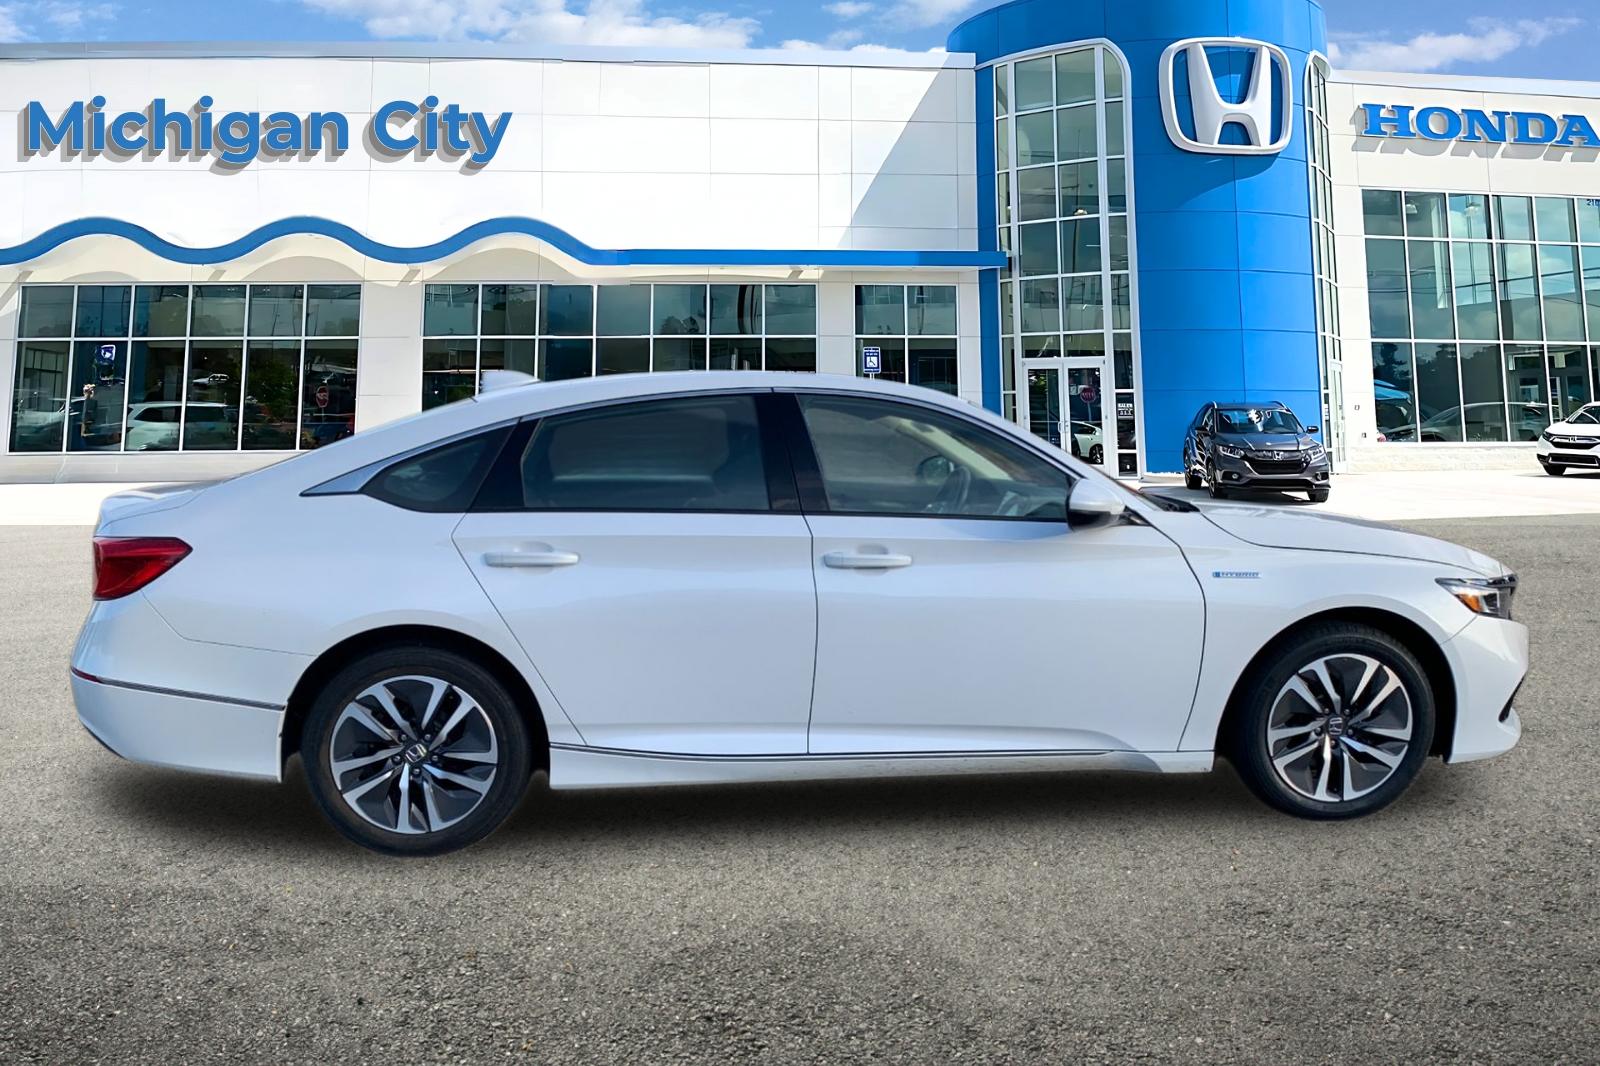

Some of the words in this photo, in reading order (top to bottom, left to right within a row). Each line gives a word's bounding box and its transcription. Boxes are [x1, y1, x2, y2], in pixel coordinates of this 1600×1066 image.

[29, 95, 349, 164] Michigan
[374, 95, 513, 164] City
[1361, 103, 1600, 147] HONDA
